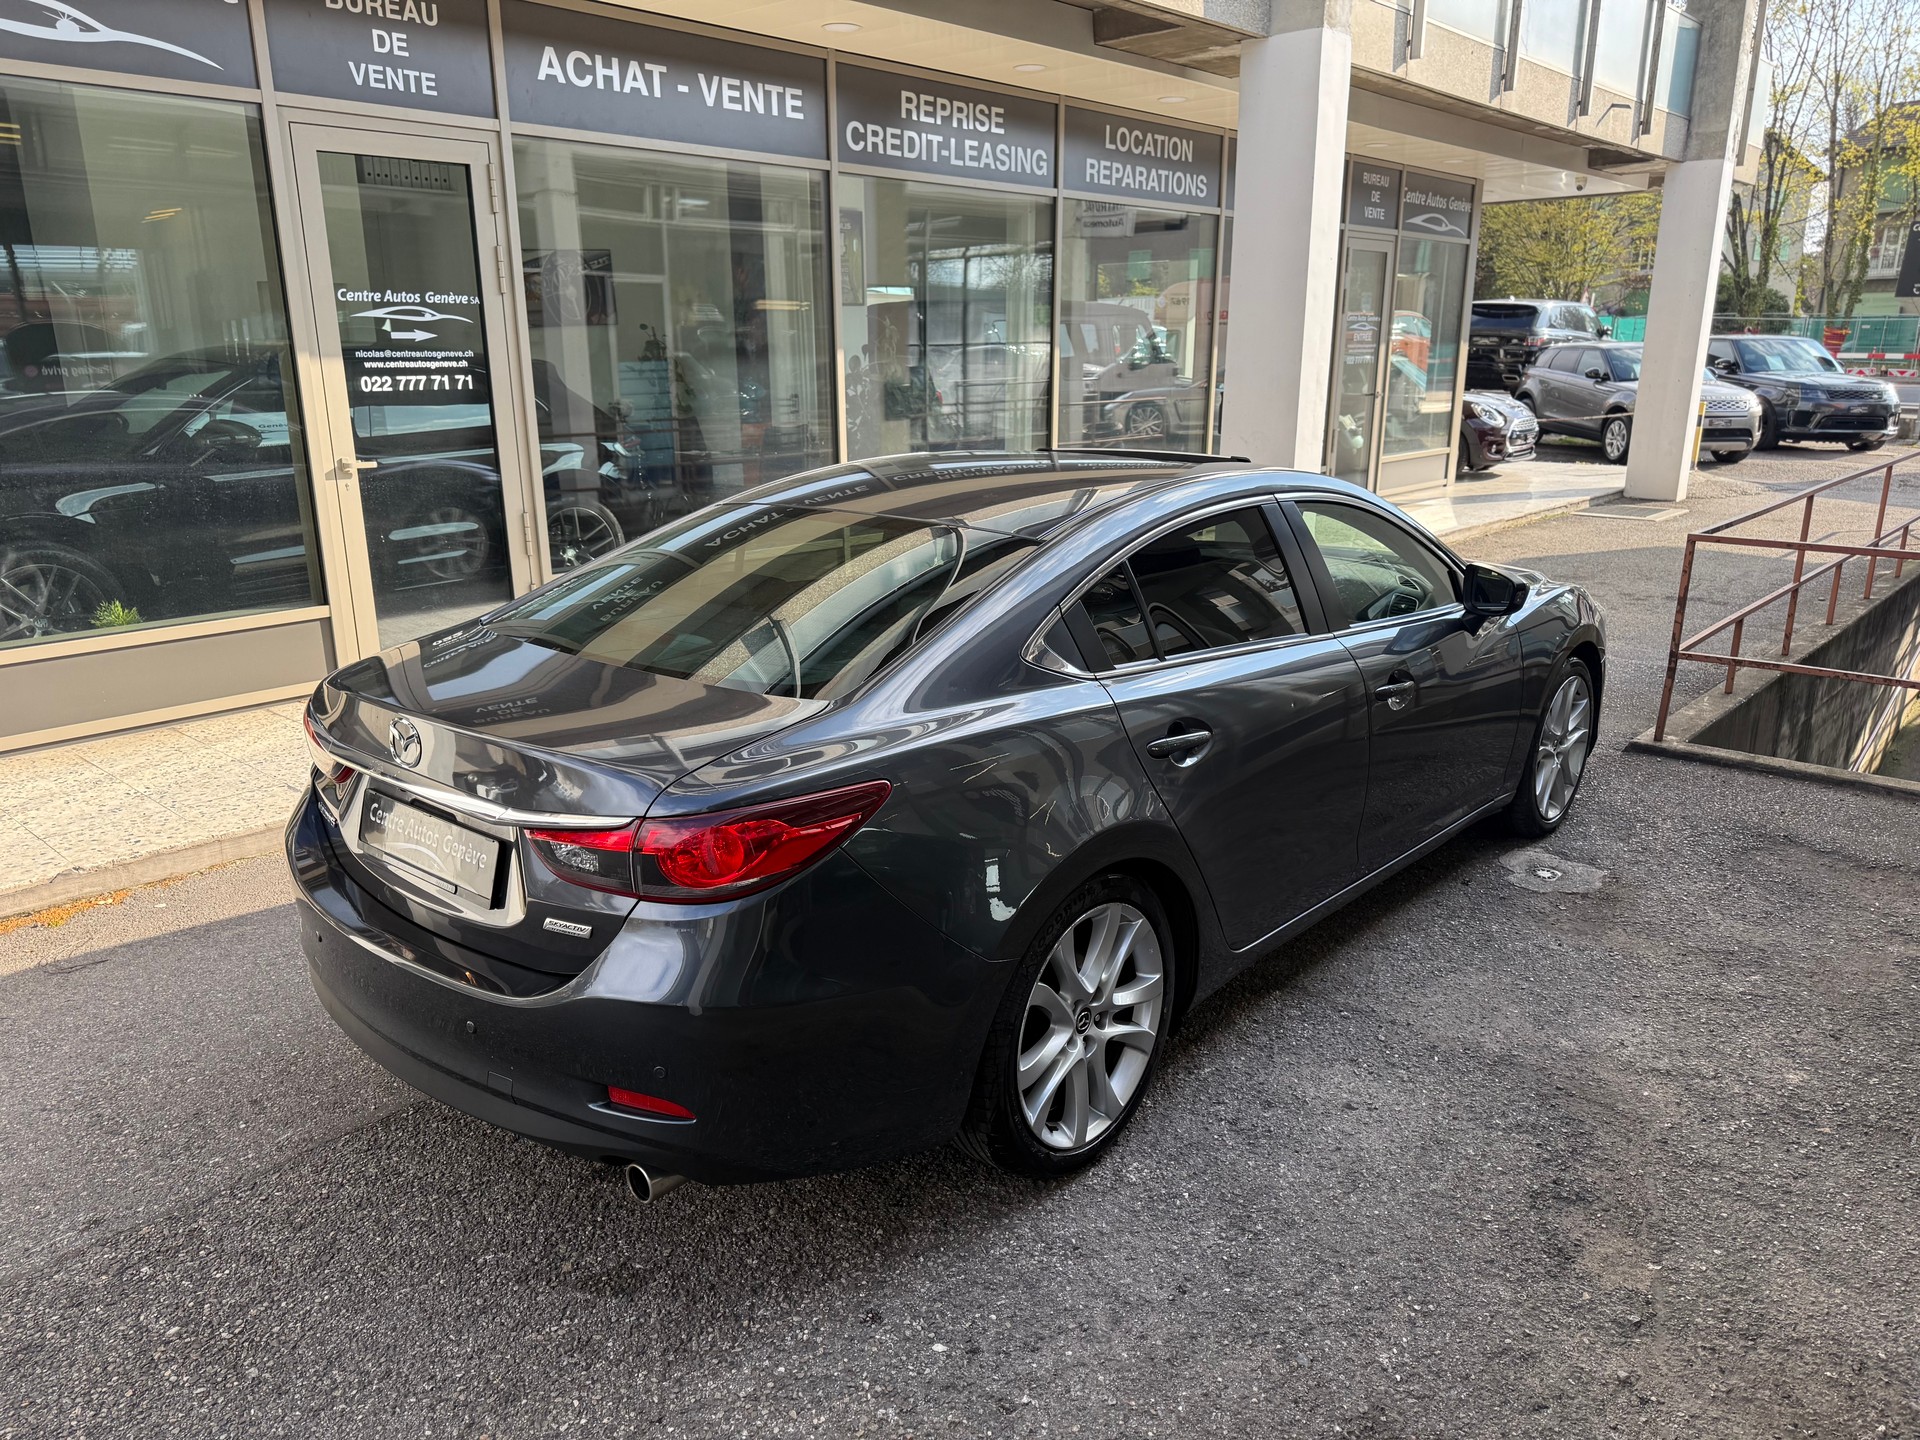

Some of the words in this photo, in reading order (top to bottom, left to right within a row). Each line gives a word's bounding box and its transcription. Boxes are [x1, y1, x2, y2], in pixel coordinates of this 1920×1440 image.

[372, 28, 410, 57] DE
[348, 61, 438, 96] VENTE
[537, 46, 667, 98] ACHAT
[677, 84, 689, 93] -
[697, 72, 804, 120] VENTE
[901, 90, 1005, 134] REPRISE
[845, 120, 1048, 175] CREDIT-LEASING
[1105, 124, 1193, 162] LOCATION
[1085, 158, 1207, 198] REPARATIONS
[1363, 172, 1390, 187] BUREAU
[1371, 190, 1381, 203] DE
[1425, 192, 1447, 209] Autos
[1364, 206, 1385, 220] VENTE
[337, 288, 382, 302] Centre
[384, 289, 421, 303] Autos
[425, 291, 468, 304] Genève
[470, 296, 480, 305] SA
[355, 350, 474, 359] nicolas@centreautosgeneve.ch
[364, 360, 469, 369] www.centreautosgeneve.ch
[360, 376, 393, 392] 022
[396, 375, 426, 391] 777
[431, 374, 450, 391] 71
[455, 374, 473, 390] 71
[369, 802, 404, 833] Centre
[405, 819, 440, 848] Autos
[442, 834, 487, 869] Genève
[548, 920, 590, 933] SKYACTIV
